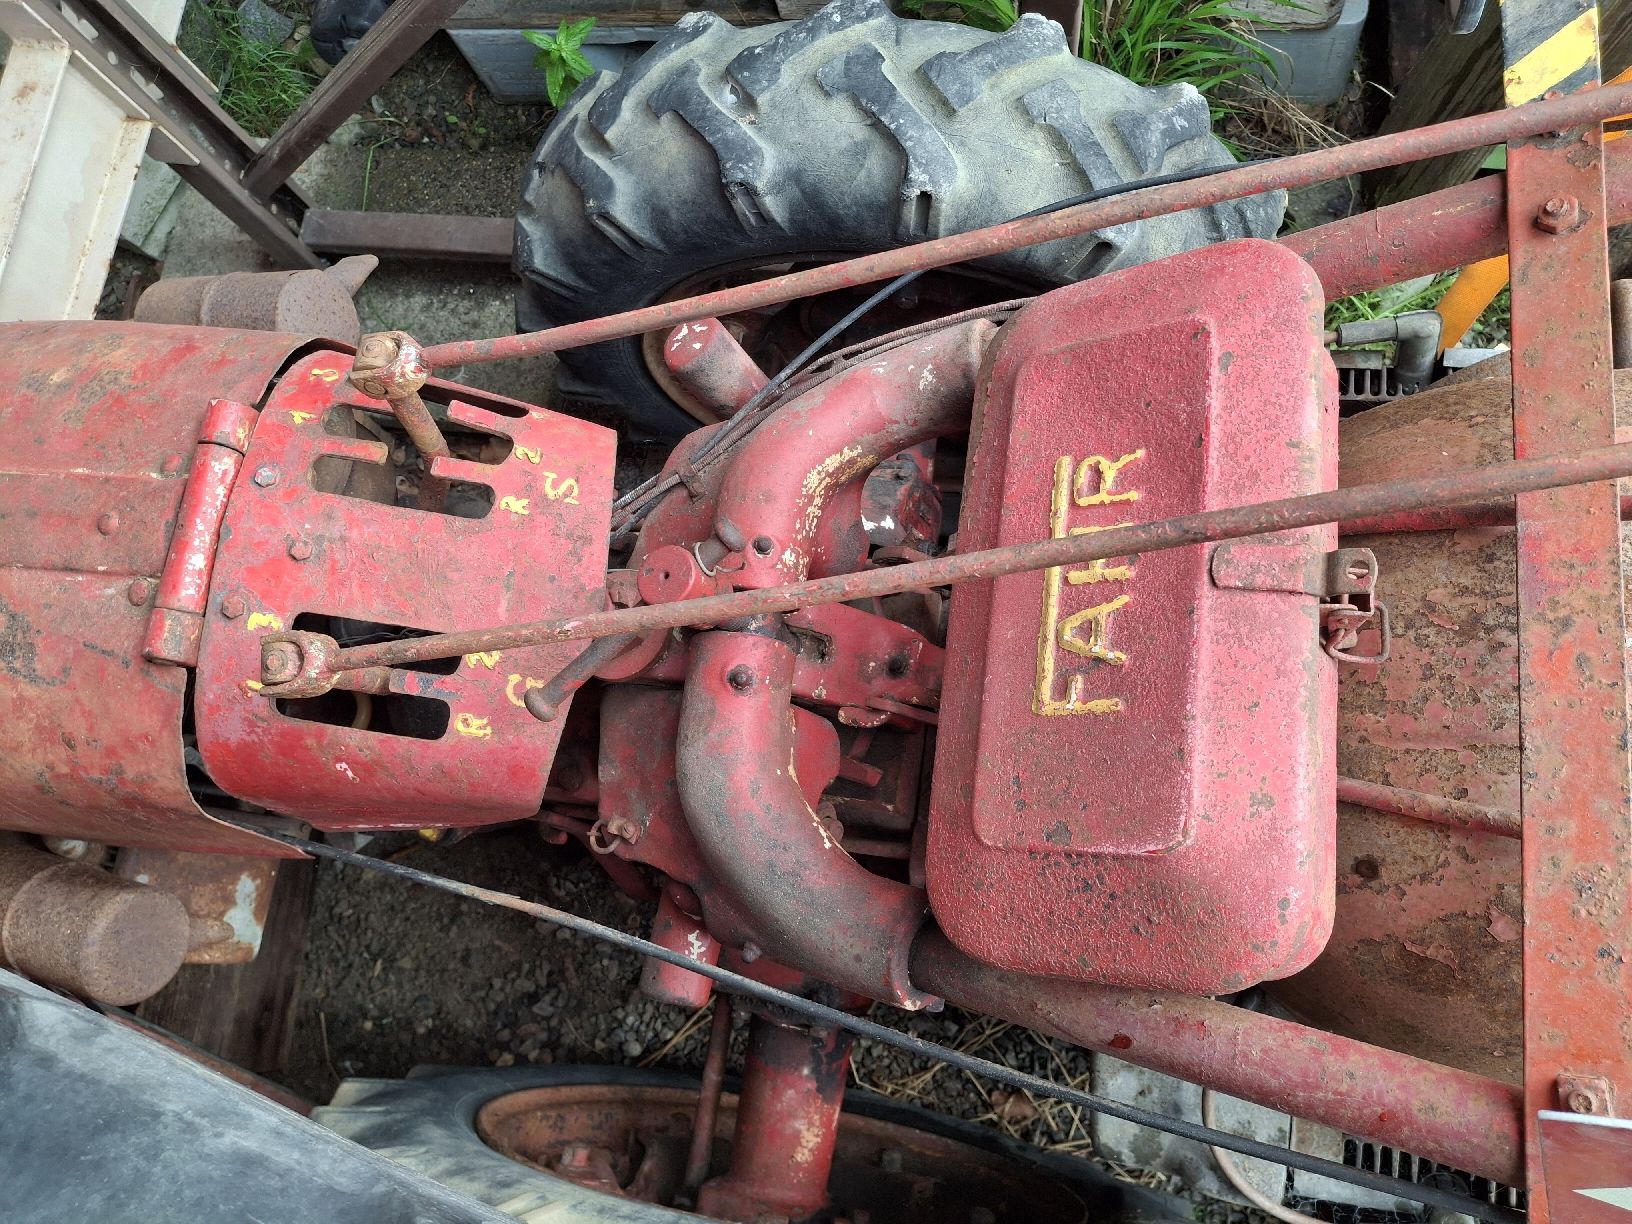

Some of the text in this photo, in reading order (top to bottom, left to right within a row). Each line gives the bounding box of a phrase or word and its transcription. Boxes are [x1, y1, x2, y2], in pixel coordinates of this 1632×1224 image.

[515, 445, 543, 464] 2
[543, 471, 580, 505] S
[499, 495, 530, 515] R
[1032, 450, 1144, 715] FAHR
[454, 713, 492, 740] R
